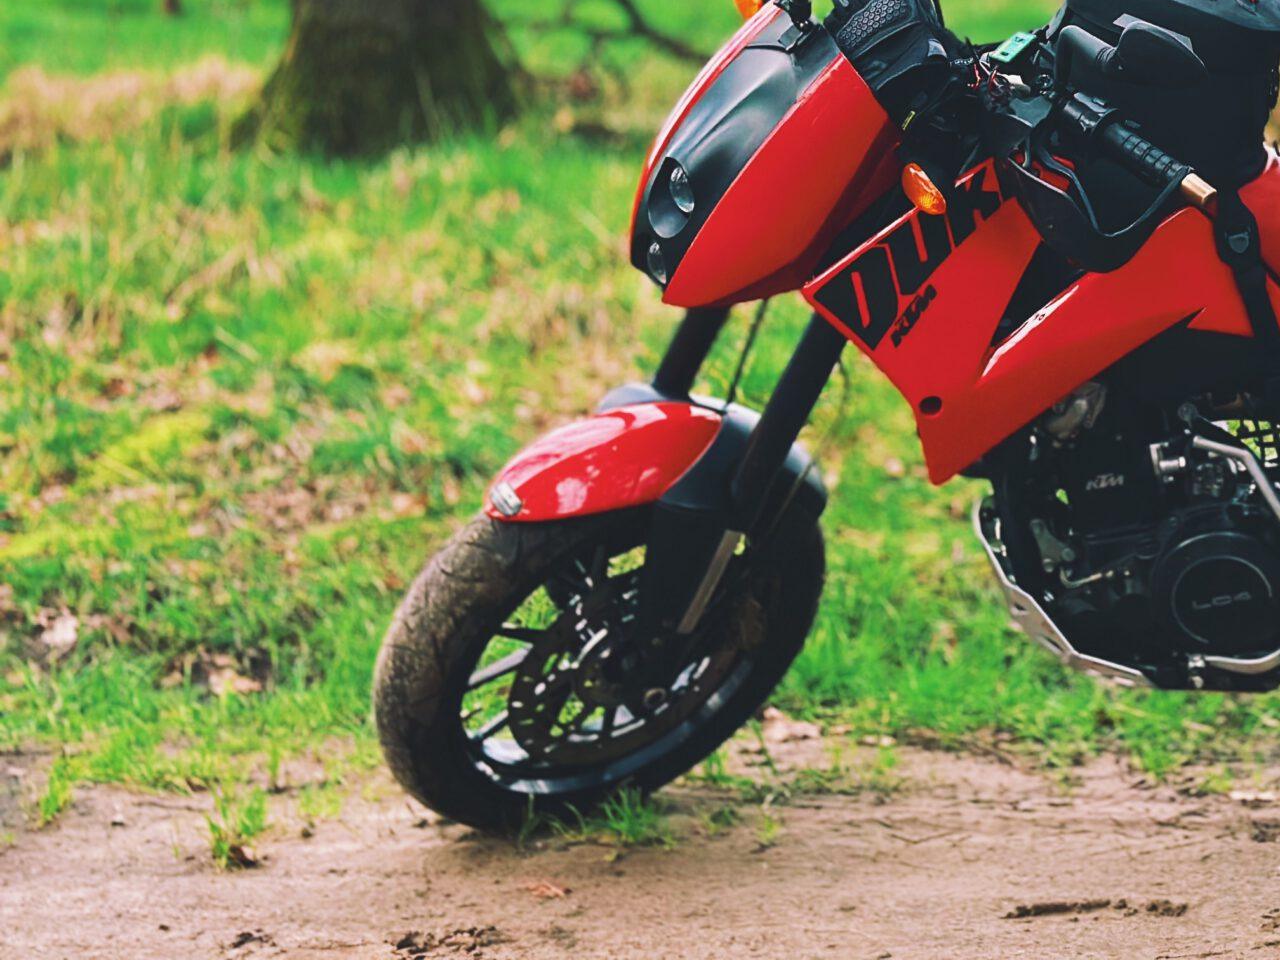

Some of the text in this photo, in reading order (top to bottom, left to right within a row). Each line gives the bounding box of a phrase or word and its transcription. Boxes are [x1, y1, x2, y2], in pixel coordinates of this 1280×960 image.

[813, 156, 1016, 352] DUK
[890, 284, 938, 349] KTM
[1086, 472, 1124, 491] KTM
